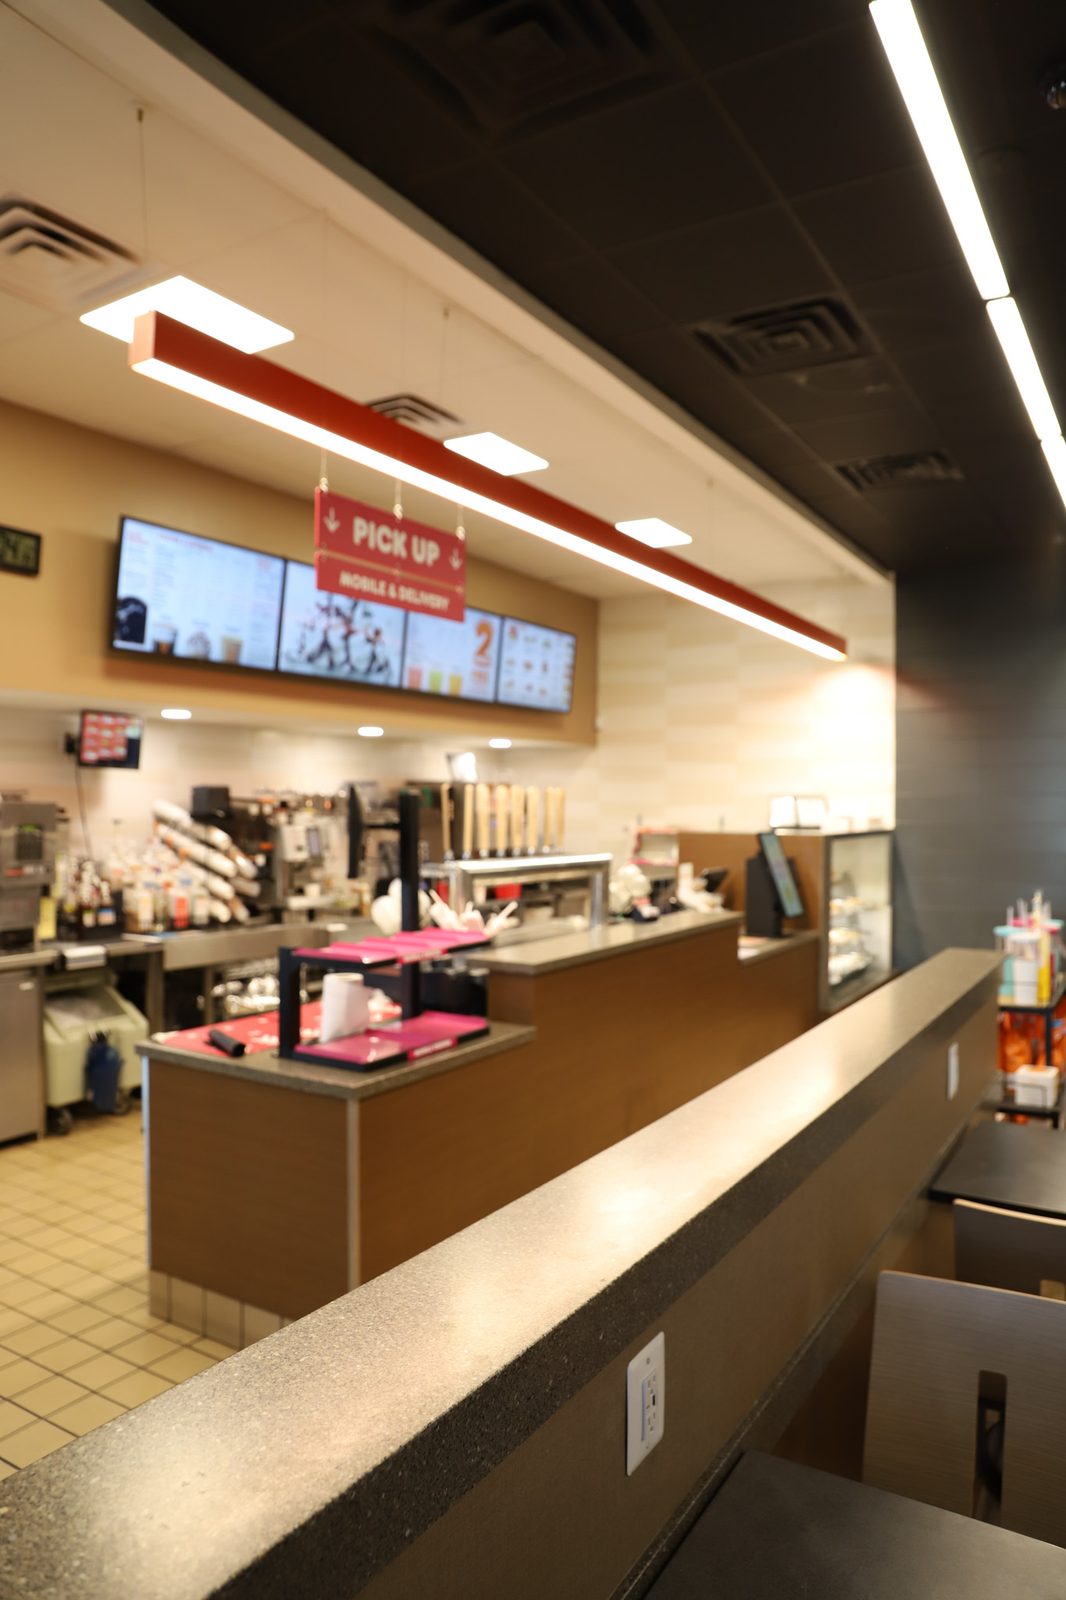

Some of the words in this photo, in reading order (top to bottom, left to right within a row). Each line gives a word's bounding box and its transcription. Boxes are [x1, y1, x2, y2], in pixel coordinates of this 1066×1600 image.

[353, 516, 407, 558] PICK
[411, 535, 440, 566] UP
[339, 571, 386, 597] MOBILE
[388, 583, 397, 598] &
[399, 586, 449, 610] DELIVERY
[475, 621, 493, 657] 2
